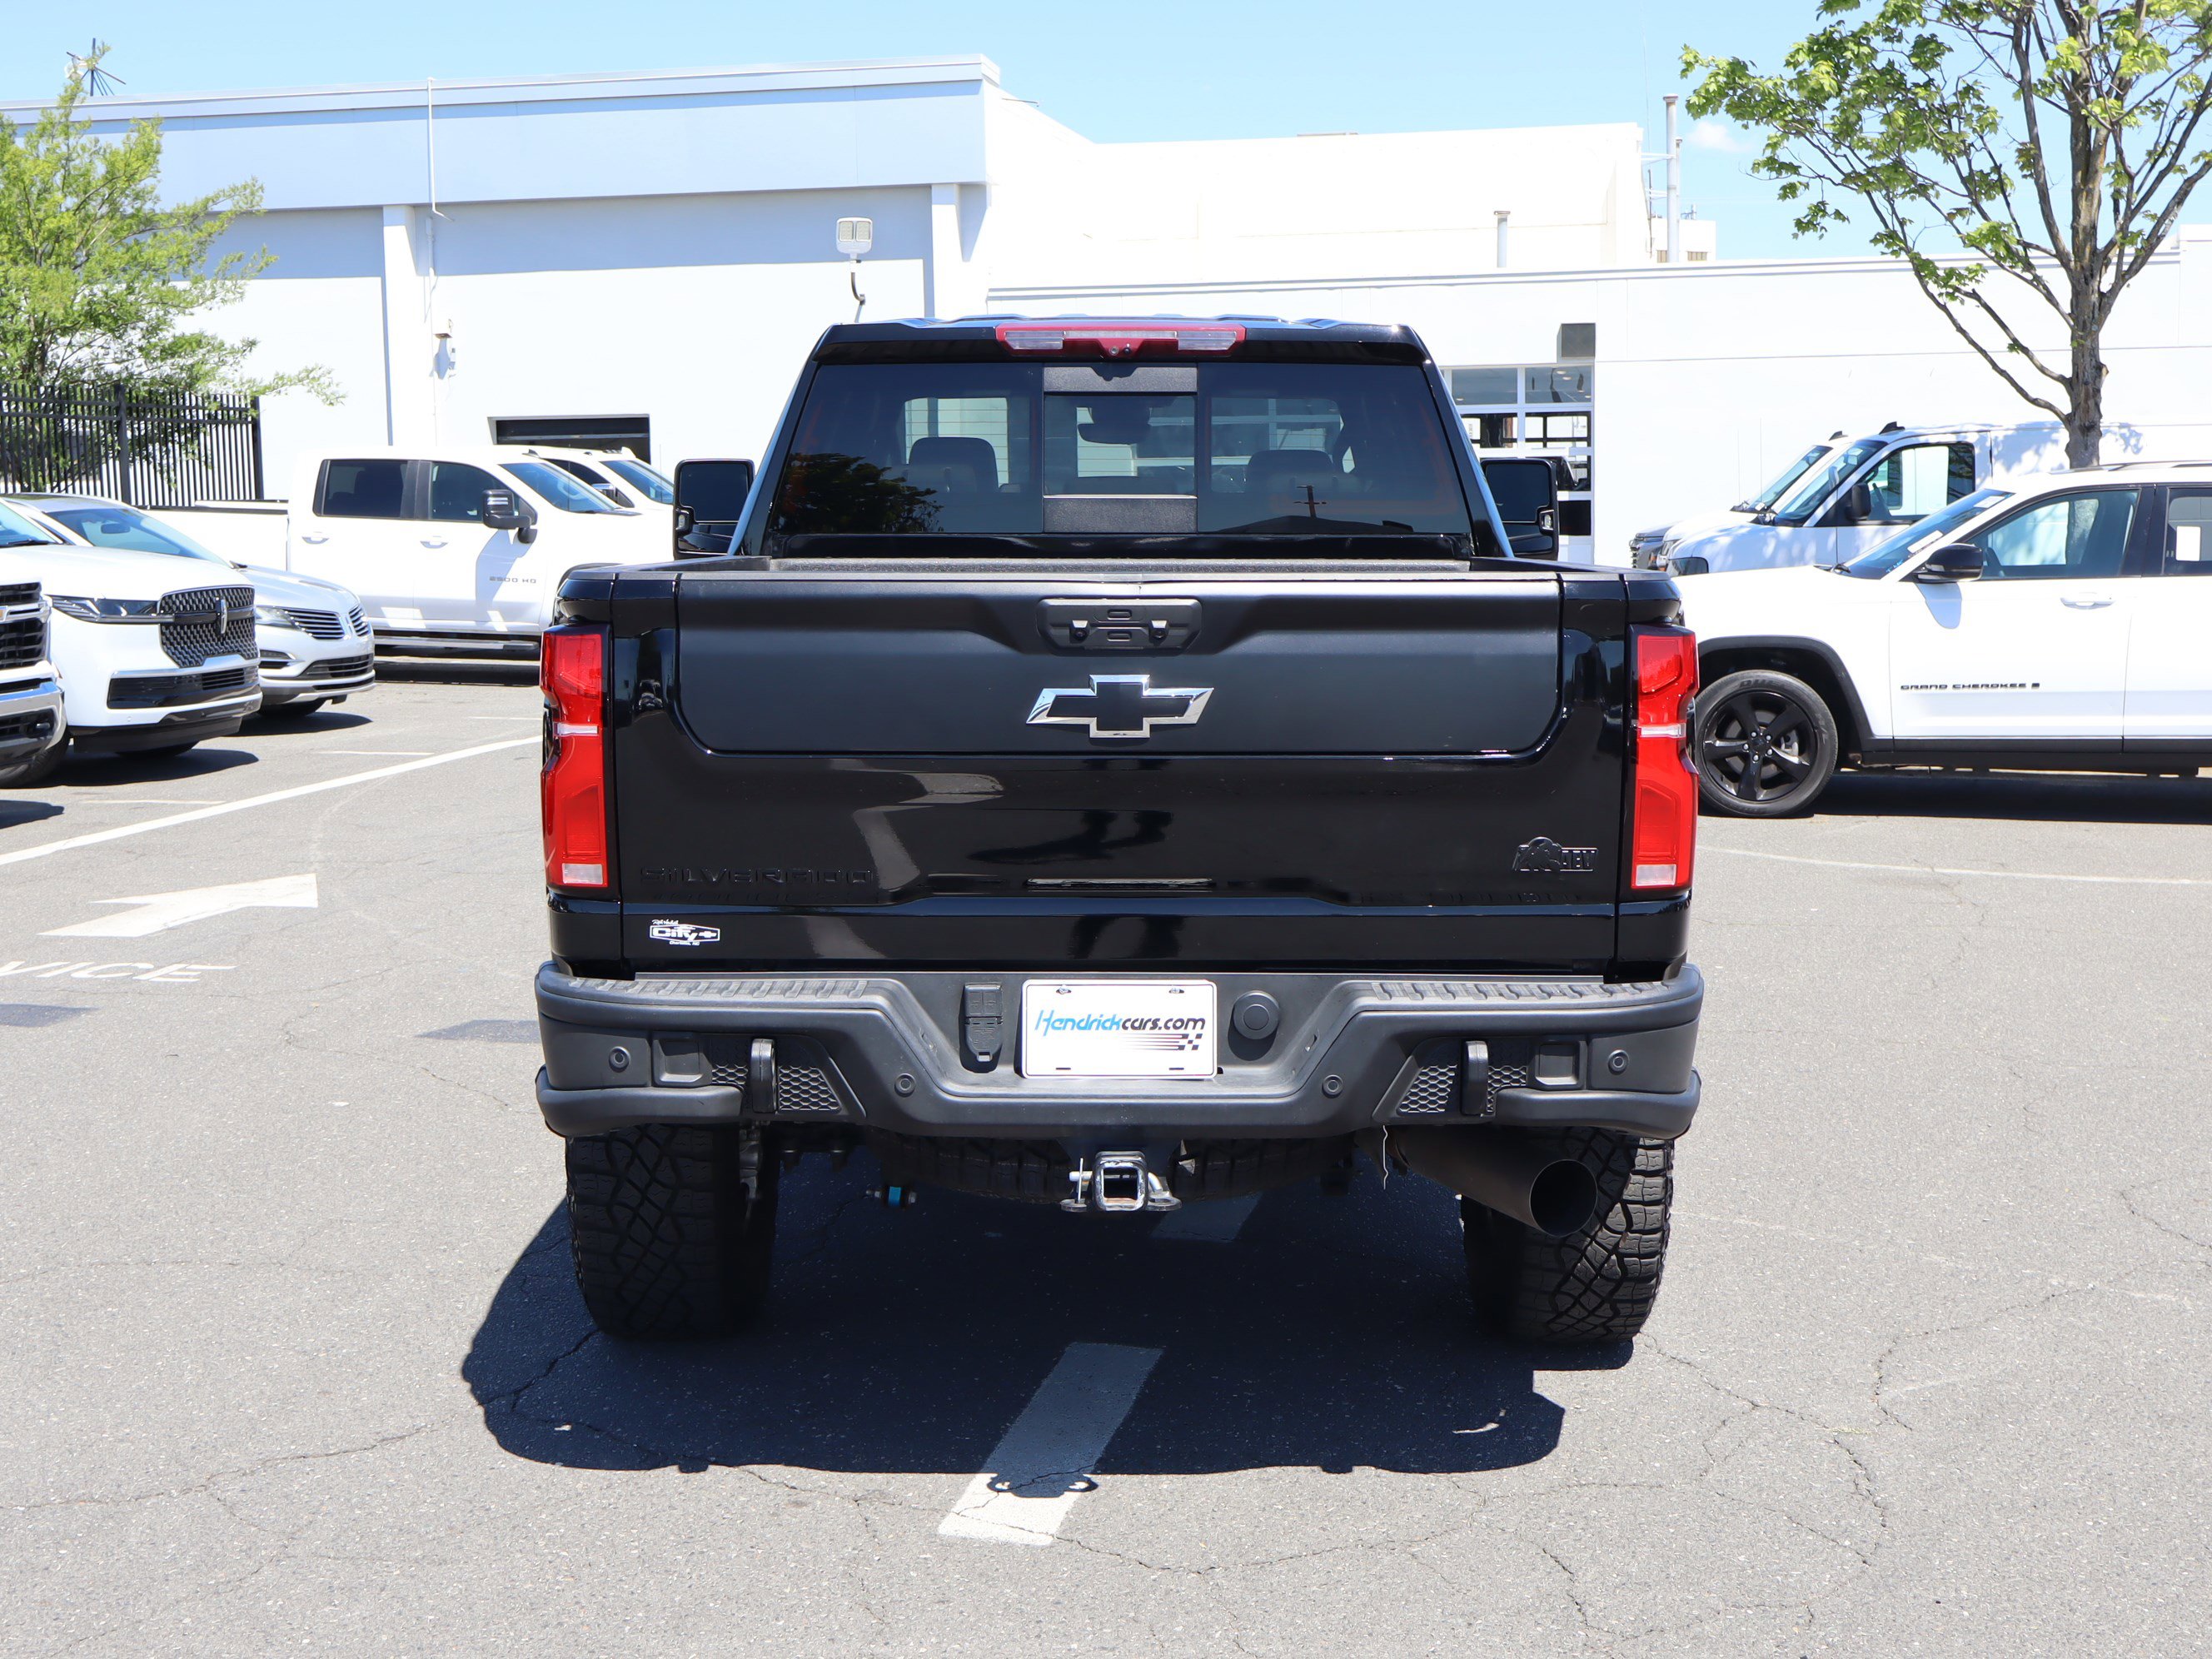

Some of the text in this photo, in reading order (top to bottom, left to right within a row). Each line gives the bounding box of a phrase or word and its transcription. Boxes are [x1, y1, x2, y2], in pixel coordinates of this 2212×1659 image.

[640, 868, 874, 884] SILVERADO
[652, 927, 698, 942] City
[1034, 1009, 1206, 1037] Hendrickcars.com
